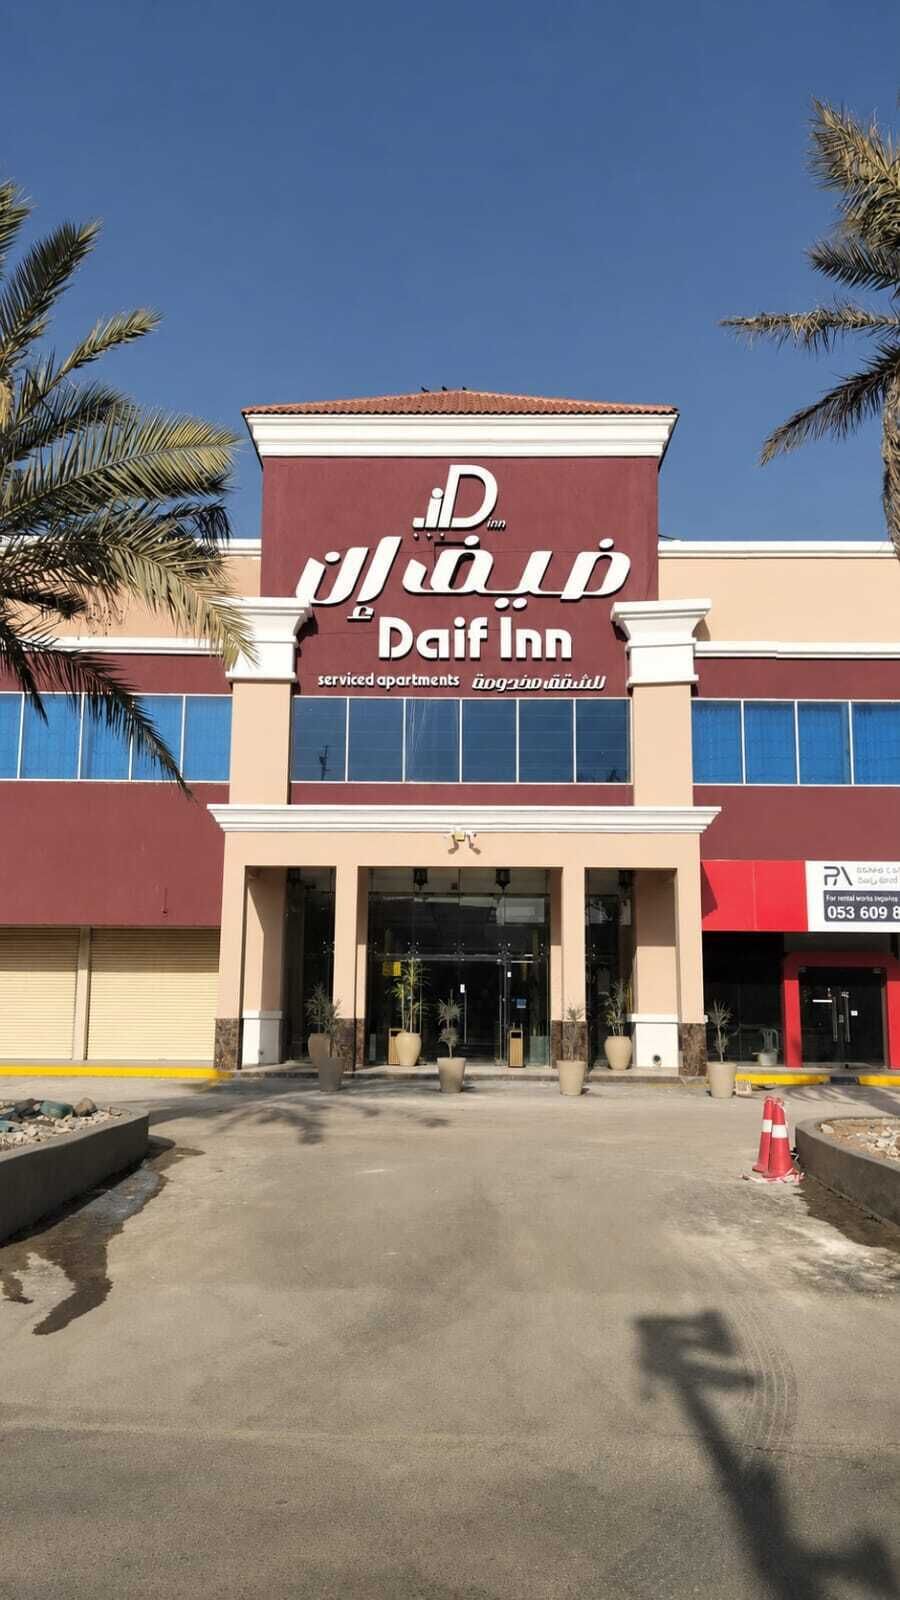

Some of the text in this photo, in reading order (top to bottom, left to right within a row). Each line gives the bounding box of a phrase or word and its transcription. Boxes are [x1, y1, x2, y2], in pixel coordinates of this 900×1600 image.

[402, 535, 631, 609] ضيف
[379, 616, 572, 659] Daif Inn
[318, 672, 460, 689] serviced apartments
[825, 894, 837, 902] For
[838, 894, 855, 902] rental
[827, 906, 855, 919] 053
[860, 906, 888, 919] 609
